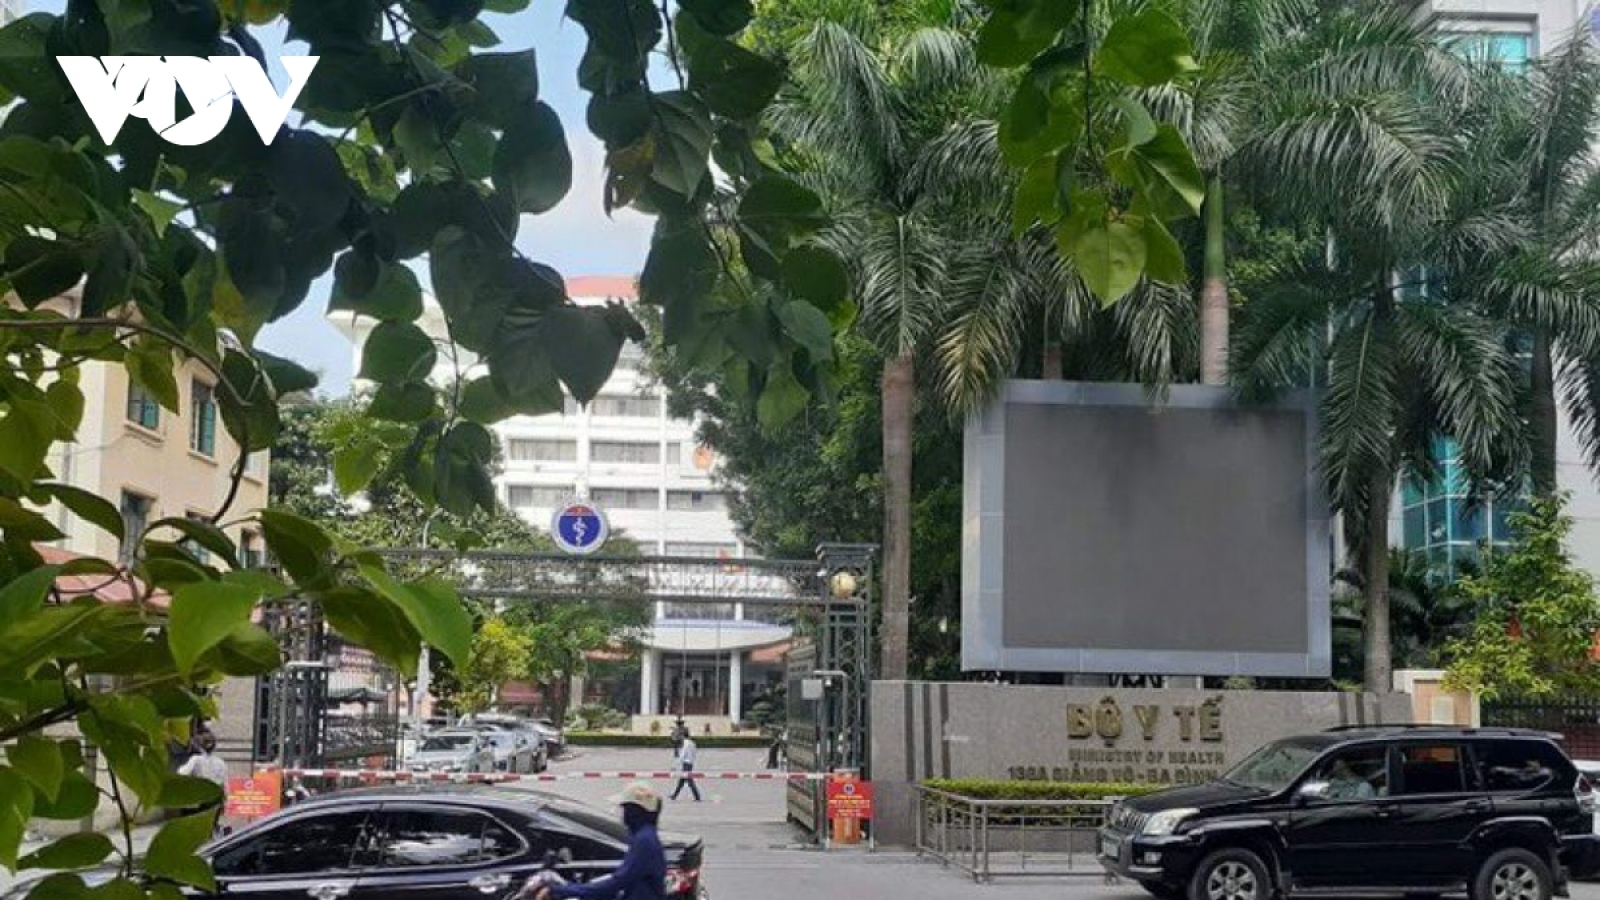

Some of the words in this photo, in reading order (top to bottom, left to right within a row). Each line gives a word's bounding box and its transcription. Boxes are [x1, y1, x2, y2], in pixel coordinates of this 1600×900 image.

[1067, 696, 1123, 747] BỘ
[1133, 705, 1160, 741] Y
[1173, 695, 1224, 742] TẾ
[1068, 748, 1142, 763] MINISTRY
[1146, 749, 1164, 764] OF
[1169, 751, 1224, 764] HEALTH
